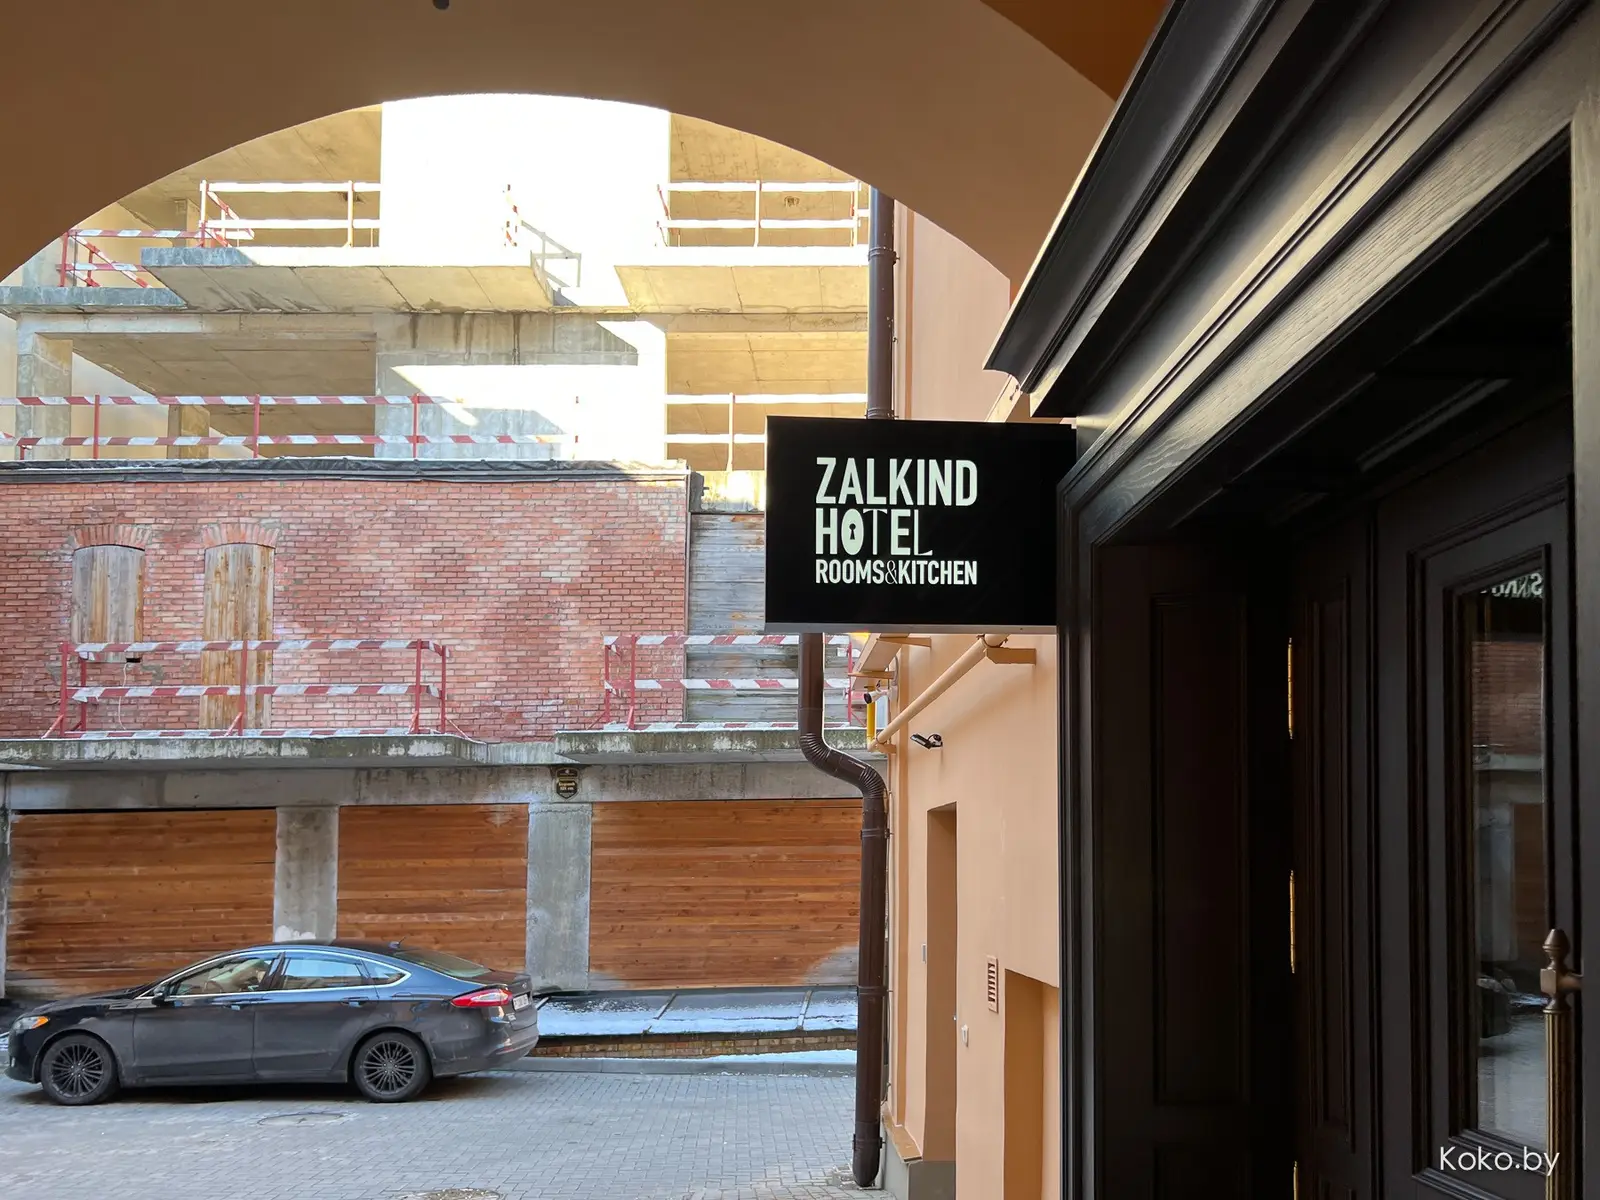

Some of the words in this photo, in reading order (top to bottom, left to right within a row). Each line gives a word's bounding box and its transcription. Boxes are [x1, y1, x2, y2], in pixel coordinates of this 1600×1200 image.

[815, 457, 978, 507] ZALKIND
[815, 508, 933, 556] HOTEL
[815, 559, 978, 585] ROOMS&KITCHEN
